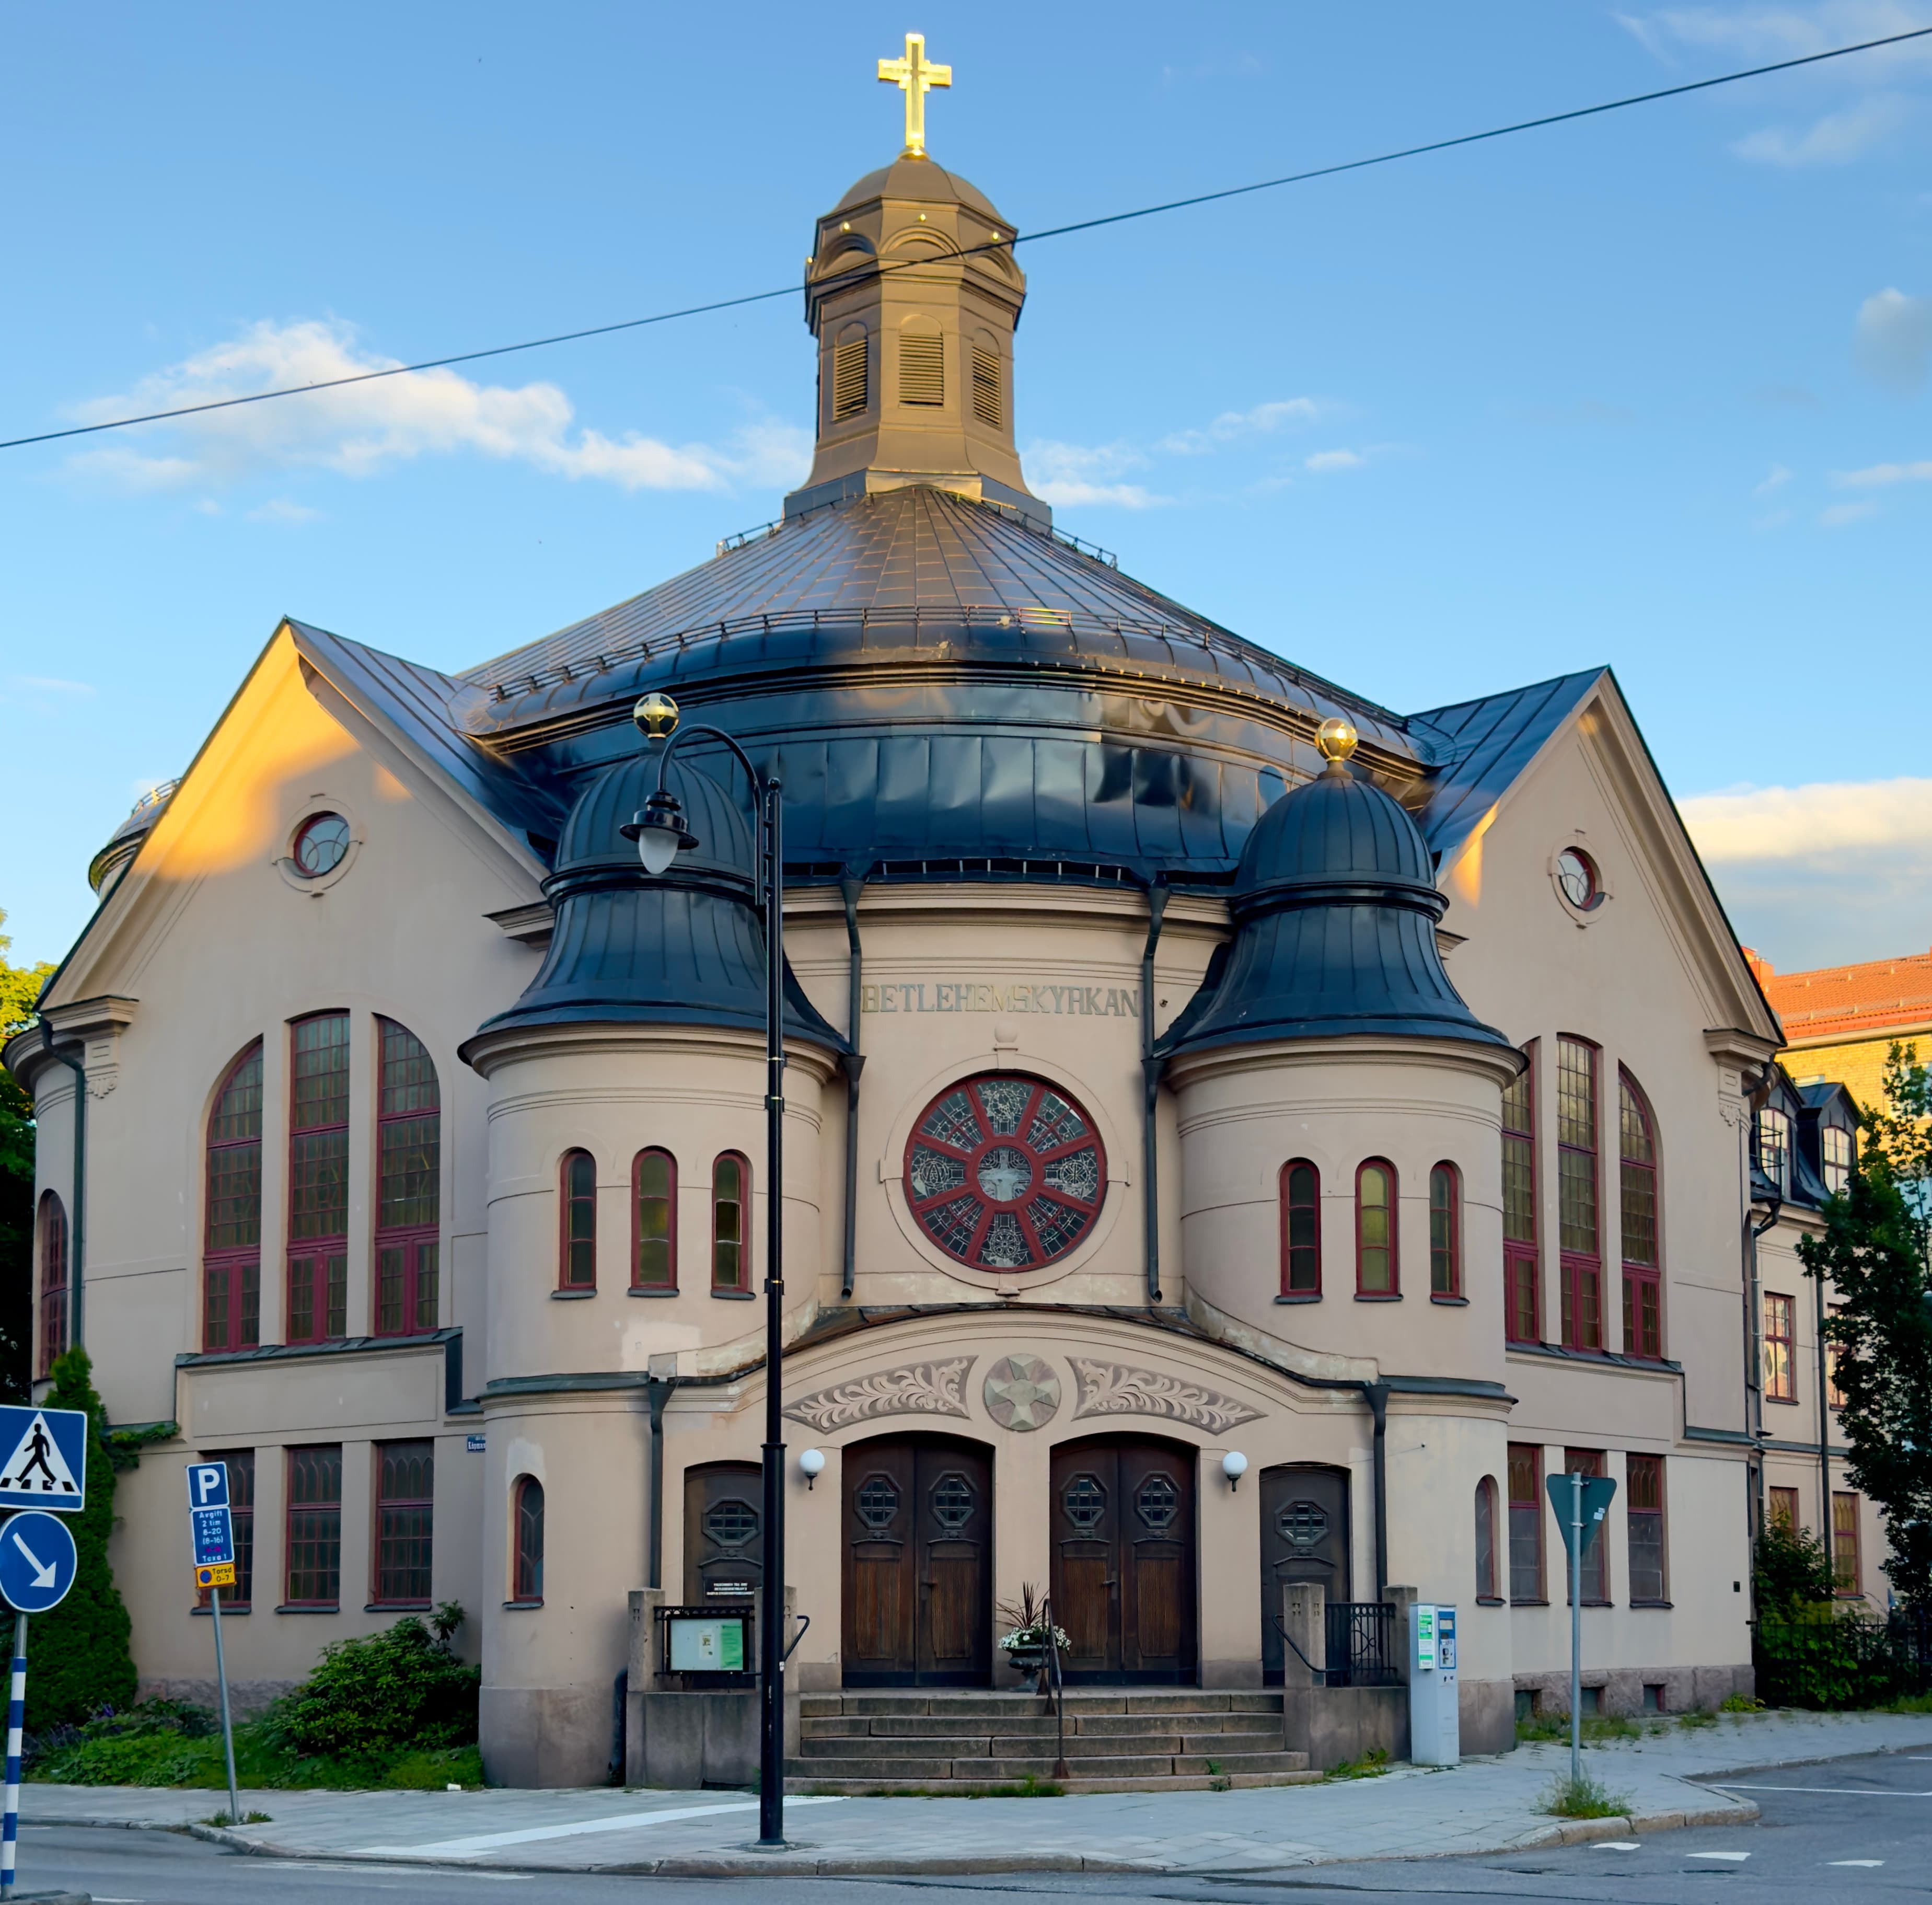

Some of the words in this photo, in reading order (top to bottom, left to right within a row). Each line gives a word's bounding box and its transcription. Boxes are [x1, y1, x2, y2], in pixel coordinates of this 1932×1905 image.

[862, 984, 1139, 1017] BETLEHEMSKYRKAN
[198, 1468, 221, 1504] P
[199, 1510, 222, 1519] Avgift
[203, 1527, 222, 1535] 8-20
[202, 1535, 224, 1545] (8-16)
[212, 1566, 232, 1575] Torsd
